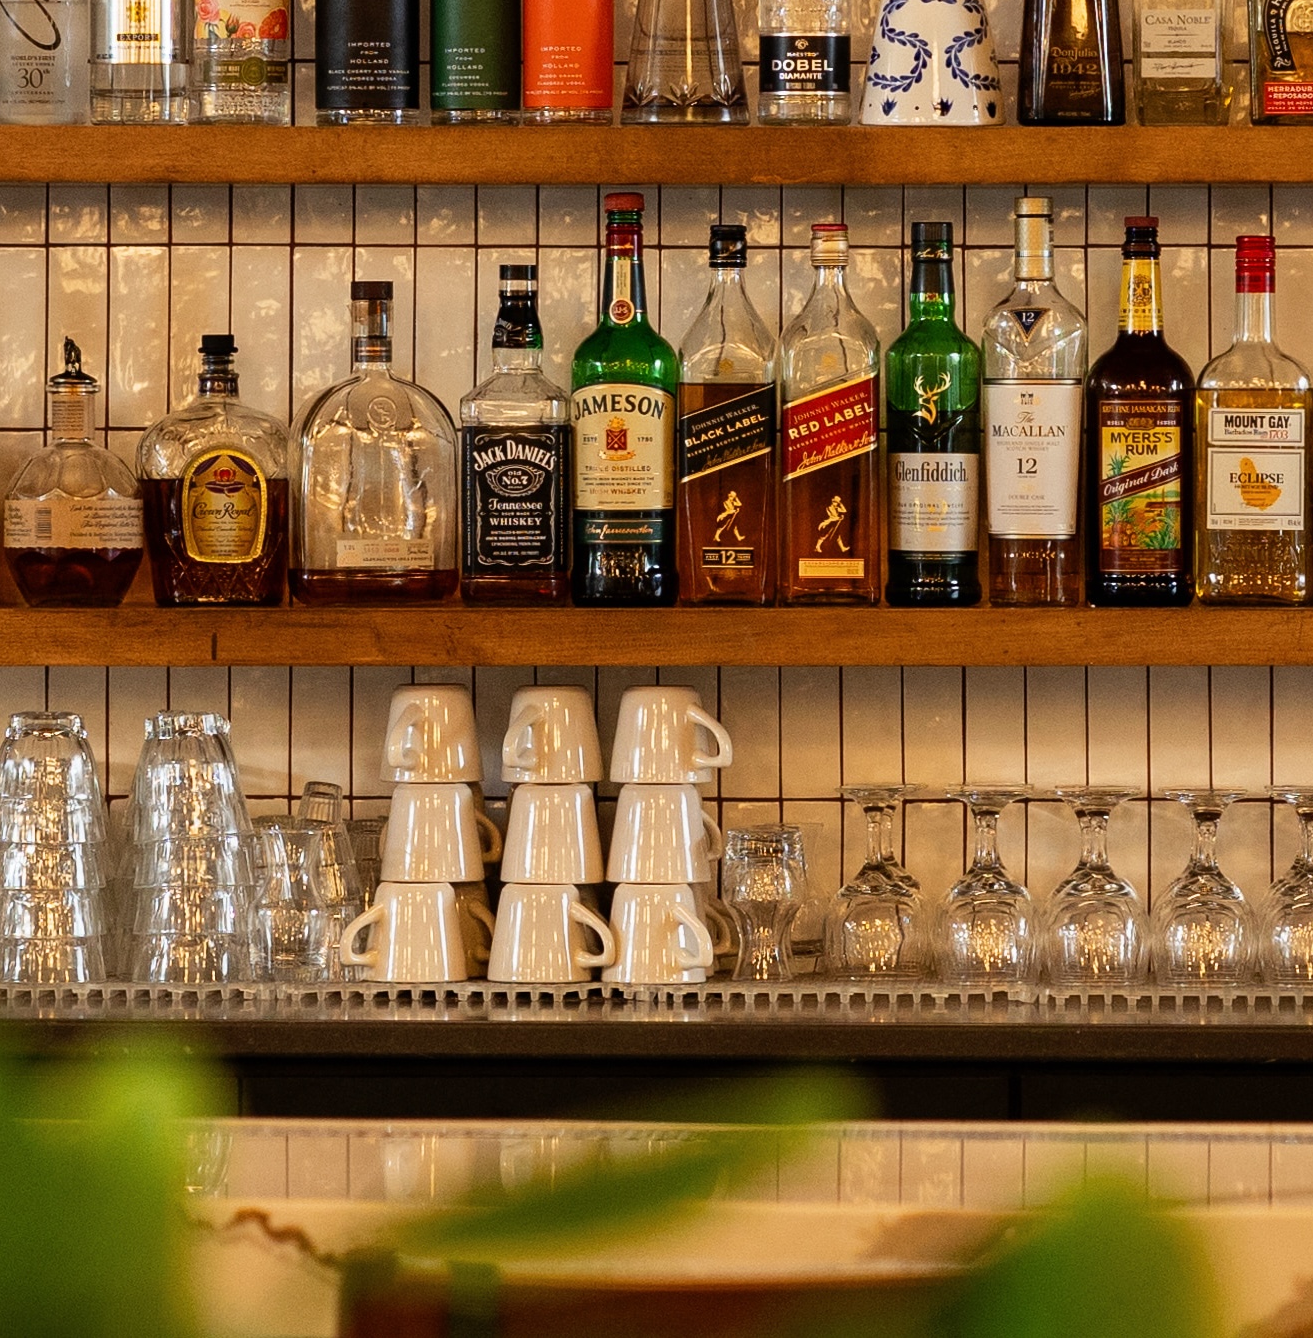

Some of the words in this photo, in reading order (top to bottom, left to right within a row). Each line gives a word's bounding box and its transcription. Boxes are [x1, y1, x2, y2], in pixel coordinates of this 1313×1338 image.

[119, 33, 157, 41] EXPORT
[1270, 18, 1283, 58] TEQUILA
[771, 59, 834, 72] DOBEL
[1052, 63, 1098, 75] 1942
[779, 72, 823, 80] DIAMANTE
[1020, 312, 1035, 322] 12
[574, 394, 665, 421] JAMESON
[793, 405, 831, 425] JOHNNIE
[830, 392, 867, 409] WALKER
[1131, 405, 1167, 414] JAMAICAN
[691, 415, 726, 434] JOHNNIE
[725, 404, 758, 419] WALKER
[788, 420, 820, 440] RED
[823, 402, 873, 427] LABEL
[1015, 411, 1036, 424] The
[1224, 415, 1266, 429] MOUNT
[1268, 415, 1290, 429] GAY
[684, 426, 725, 448] BLACK
[726, 414, 766, 433] LABEL
[992, 424, 1066, 437] MACALLAN
[1269, 429, 1289, 439] 1703
[1110, 432, 1173, 443] MYERS'S
[472, 445, 506, 472] JACK
[506, 439, 557, 471] DANIEL'S
[1125, 444, 1158, 456] RUM
[895, 460, 967, 483] Glenfiddich
[1016, 457, 1038, 475] 12
[1103, 471, 1150, 496] Original
[1150, 461, 1179, 481] Dark
[1229, 472, 1285, 484] ECLIPSE
[192, 502, 222, 519] Crown
[215, 502, 255, 519] Royal
[488, 498, 543, 510] Tennessee
[489, 517, 543, 526] WHISKEY
[720, 550, 736, 564] 12
